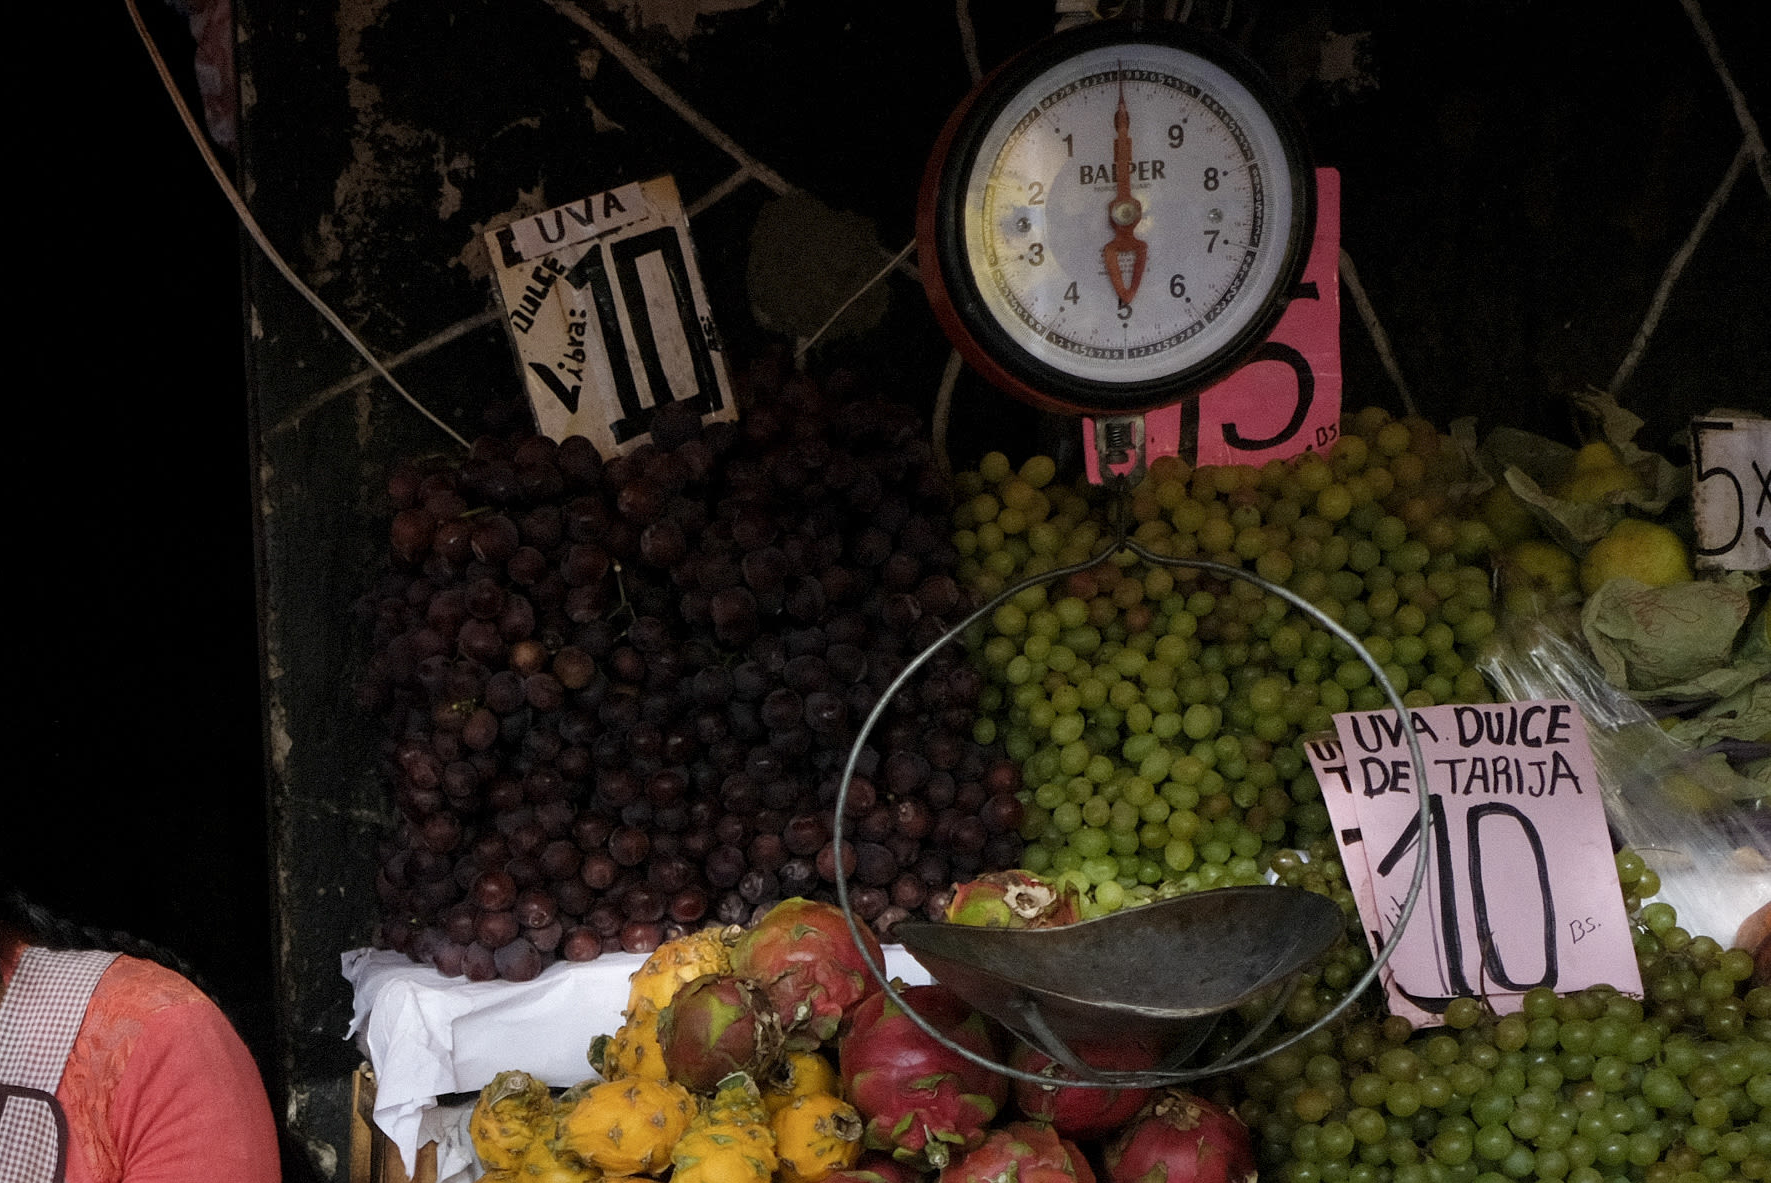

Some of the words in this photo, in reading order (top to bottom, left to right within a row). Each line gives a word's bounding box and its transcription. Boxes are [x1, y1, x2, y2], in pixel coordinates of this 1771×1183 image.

[1061, 133, 1074, 158] 1
[1167, 124, 1185, 149] 9
[1203, 167, 1220, 192] 8
[1027, 181, 1045, 206] 2
[534, 191, 626, 244] UVA
[1203, 229, 1221, 254] 7
[1027, 242, 1045, 267] 3
[1063, 281, 1080, 306] 4
[1169, 273, 1186, 299] 6
[1116, 297, 1133, 321] 5
[564, 225, 725, 446] 10
[1359, 756, 1411, 799] DE
[1433, 750, 1584, 798] TARIJA
[1377, 793, 1559, 997] 10
